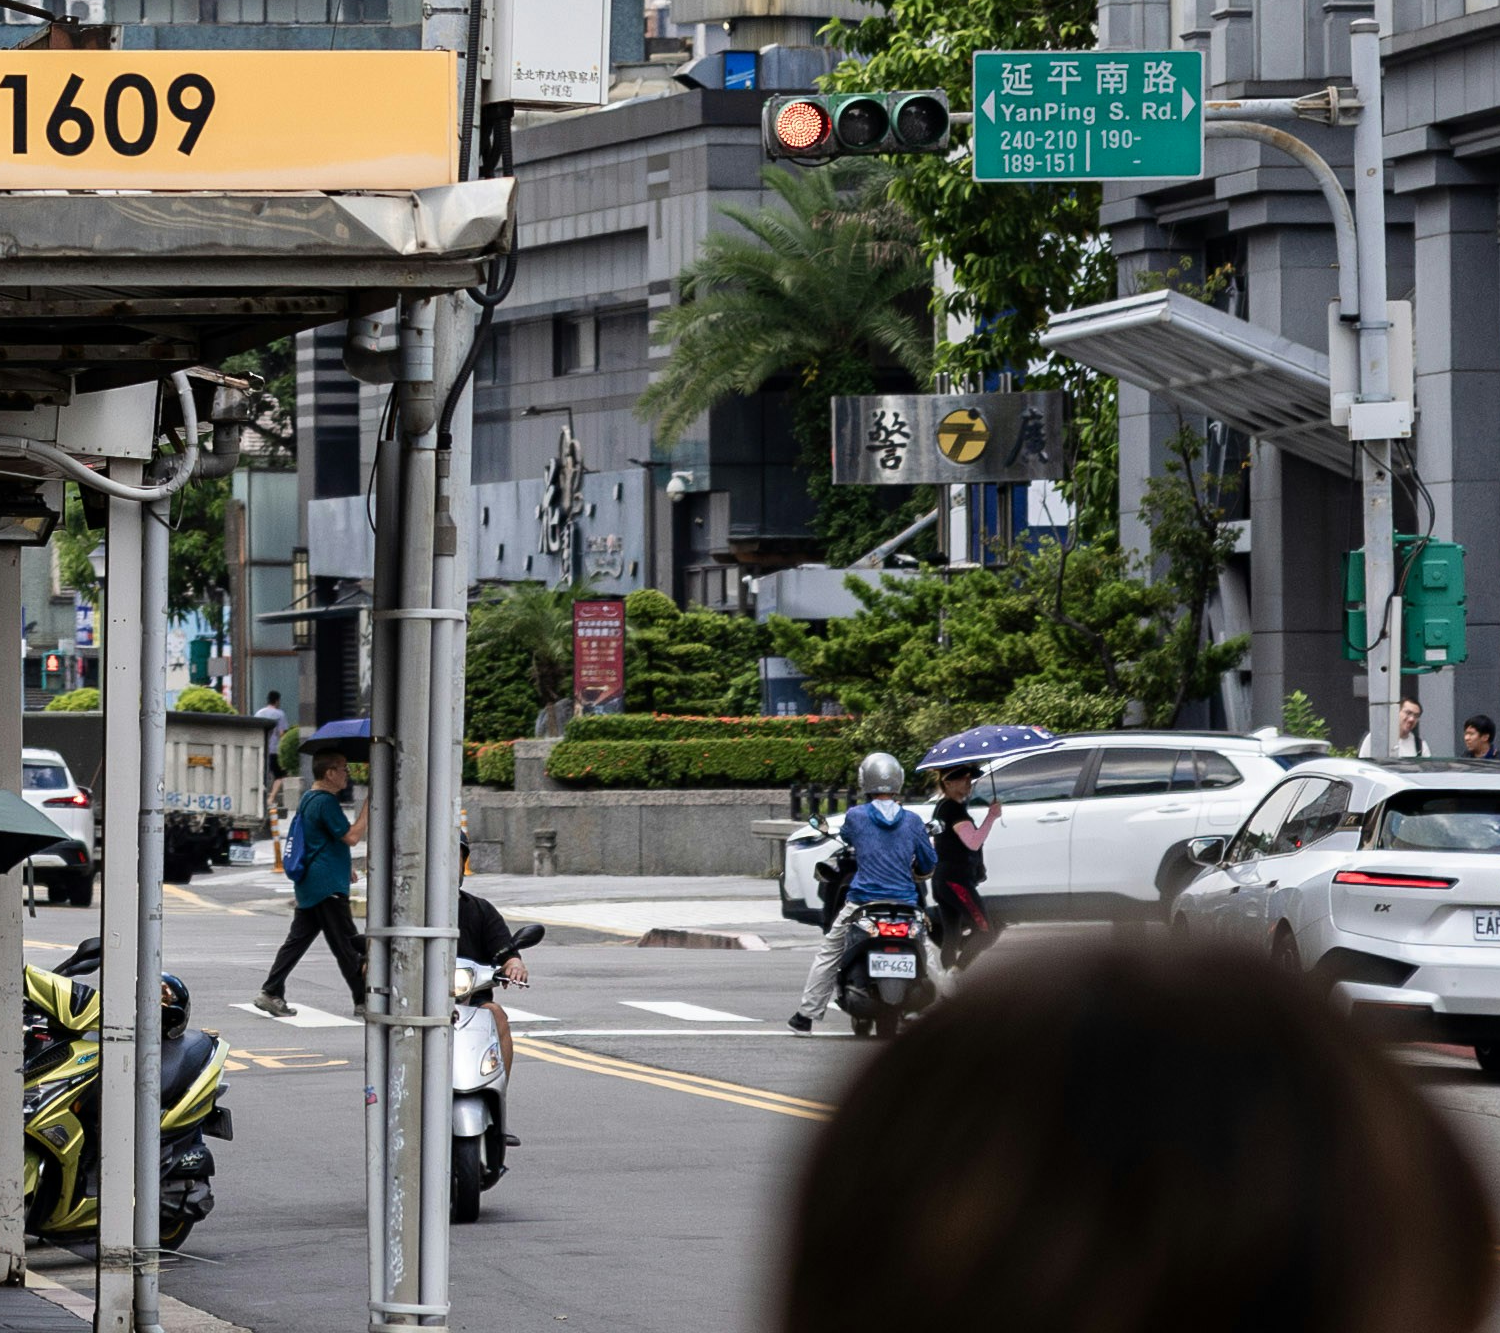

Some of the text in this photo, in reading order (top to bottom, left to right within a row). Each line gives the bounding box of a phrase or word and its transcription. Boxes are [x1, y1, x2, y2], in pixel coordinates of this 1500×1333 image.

[1000, 61, 1178, 96] 延平南路
[1000, 101, 1178, 125] YanPing S. Rd.
[1000, 129, 1077, 150] 240-210
[1003, 152, 1075, 173] 189-151
